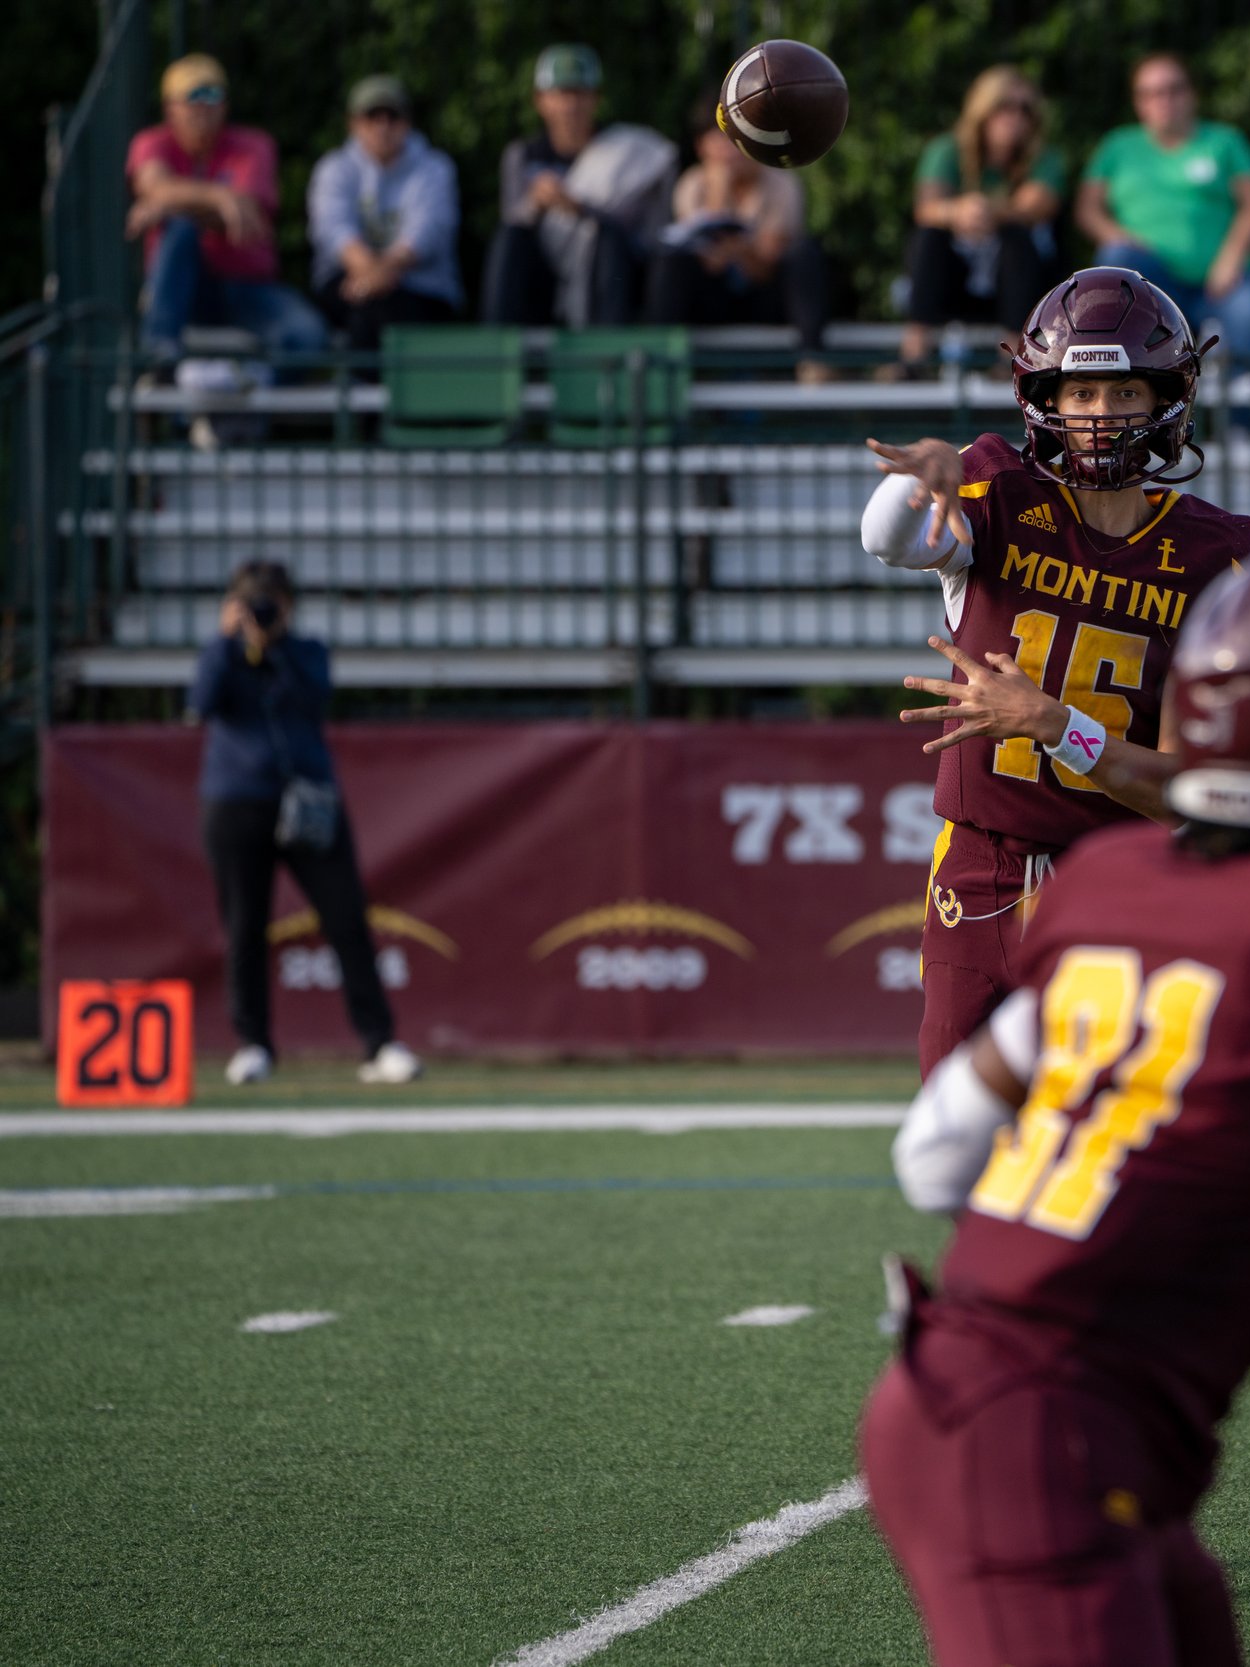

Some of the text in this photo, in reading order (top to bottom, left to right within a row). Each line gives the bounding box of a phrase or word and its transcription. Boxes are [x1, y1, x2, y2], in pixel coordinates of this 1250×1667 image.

[1071, 350, 1120, 363] MONTINI
[1018, 512, 1058, 534] adidas
[1000, 543, 1188, 629] MONTINI
[993, 608, 1150, 793] 15
[721, 782, 865, 864] 7X
[78, 1001, 172, 1089] 20
